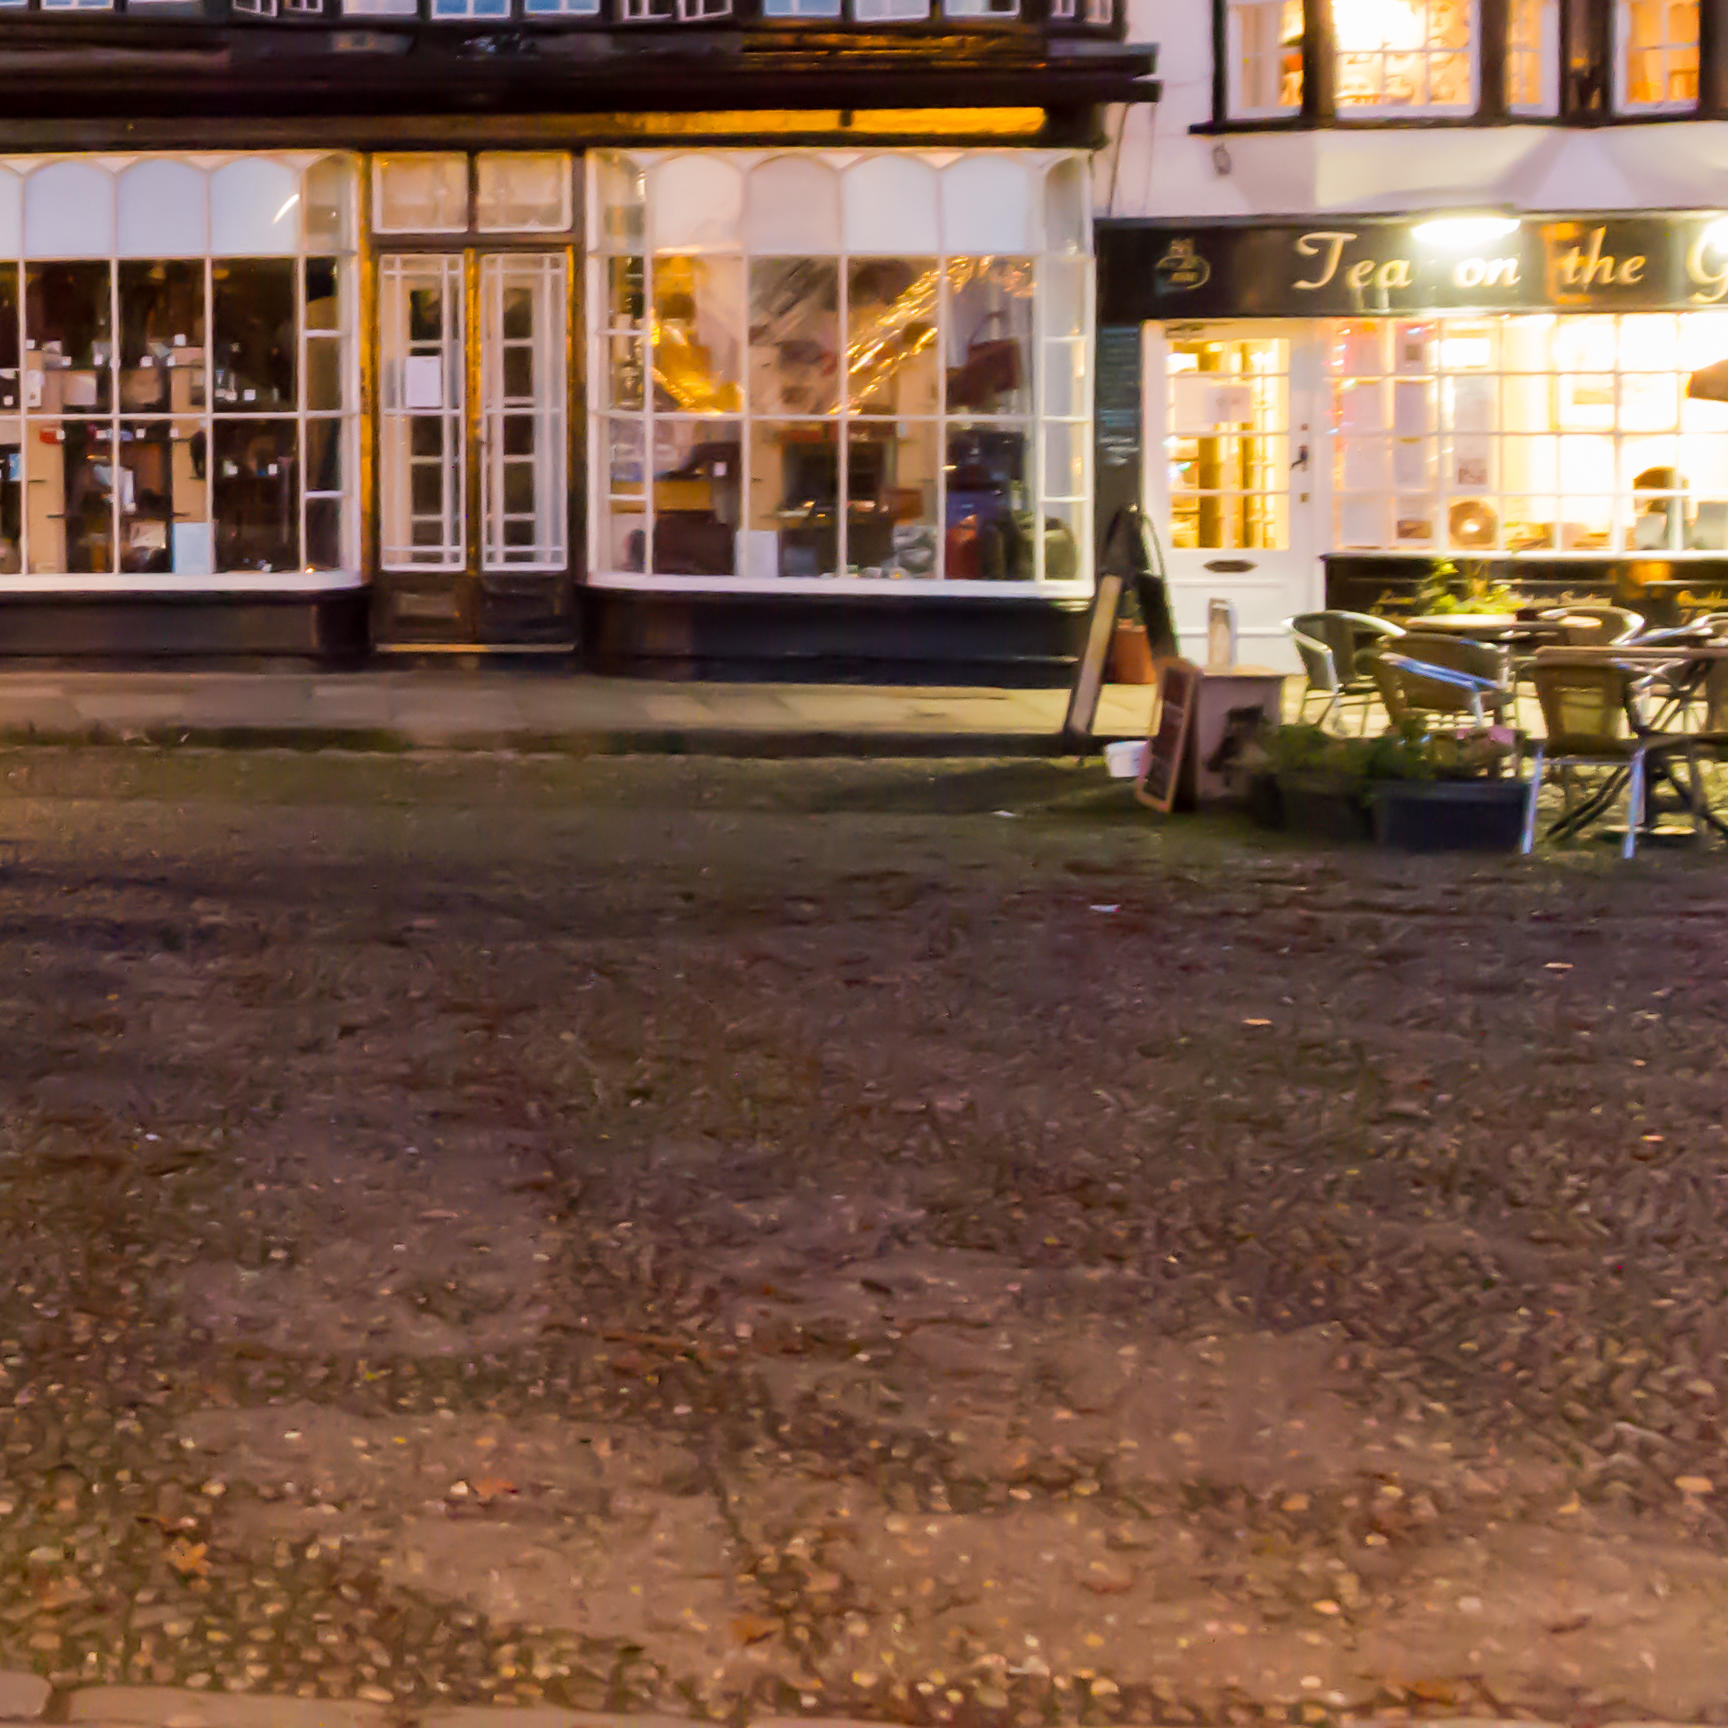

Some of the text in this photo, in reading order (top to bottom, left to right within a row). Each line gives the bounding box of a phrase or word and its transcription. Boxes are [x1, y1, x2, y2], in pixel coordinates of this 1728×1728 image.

[1294, 231, 1413, 290] Tea
[1453, 255, 1521, 289] on
[1564, 225, 1647, 292] the
